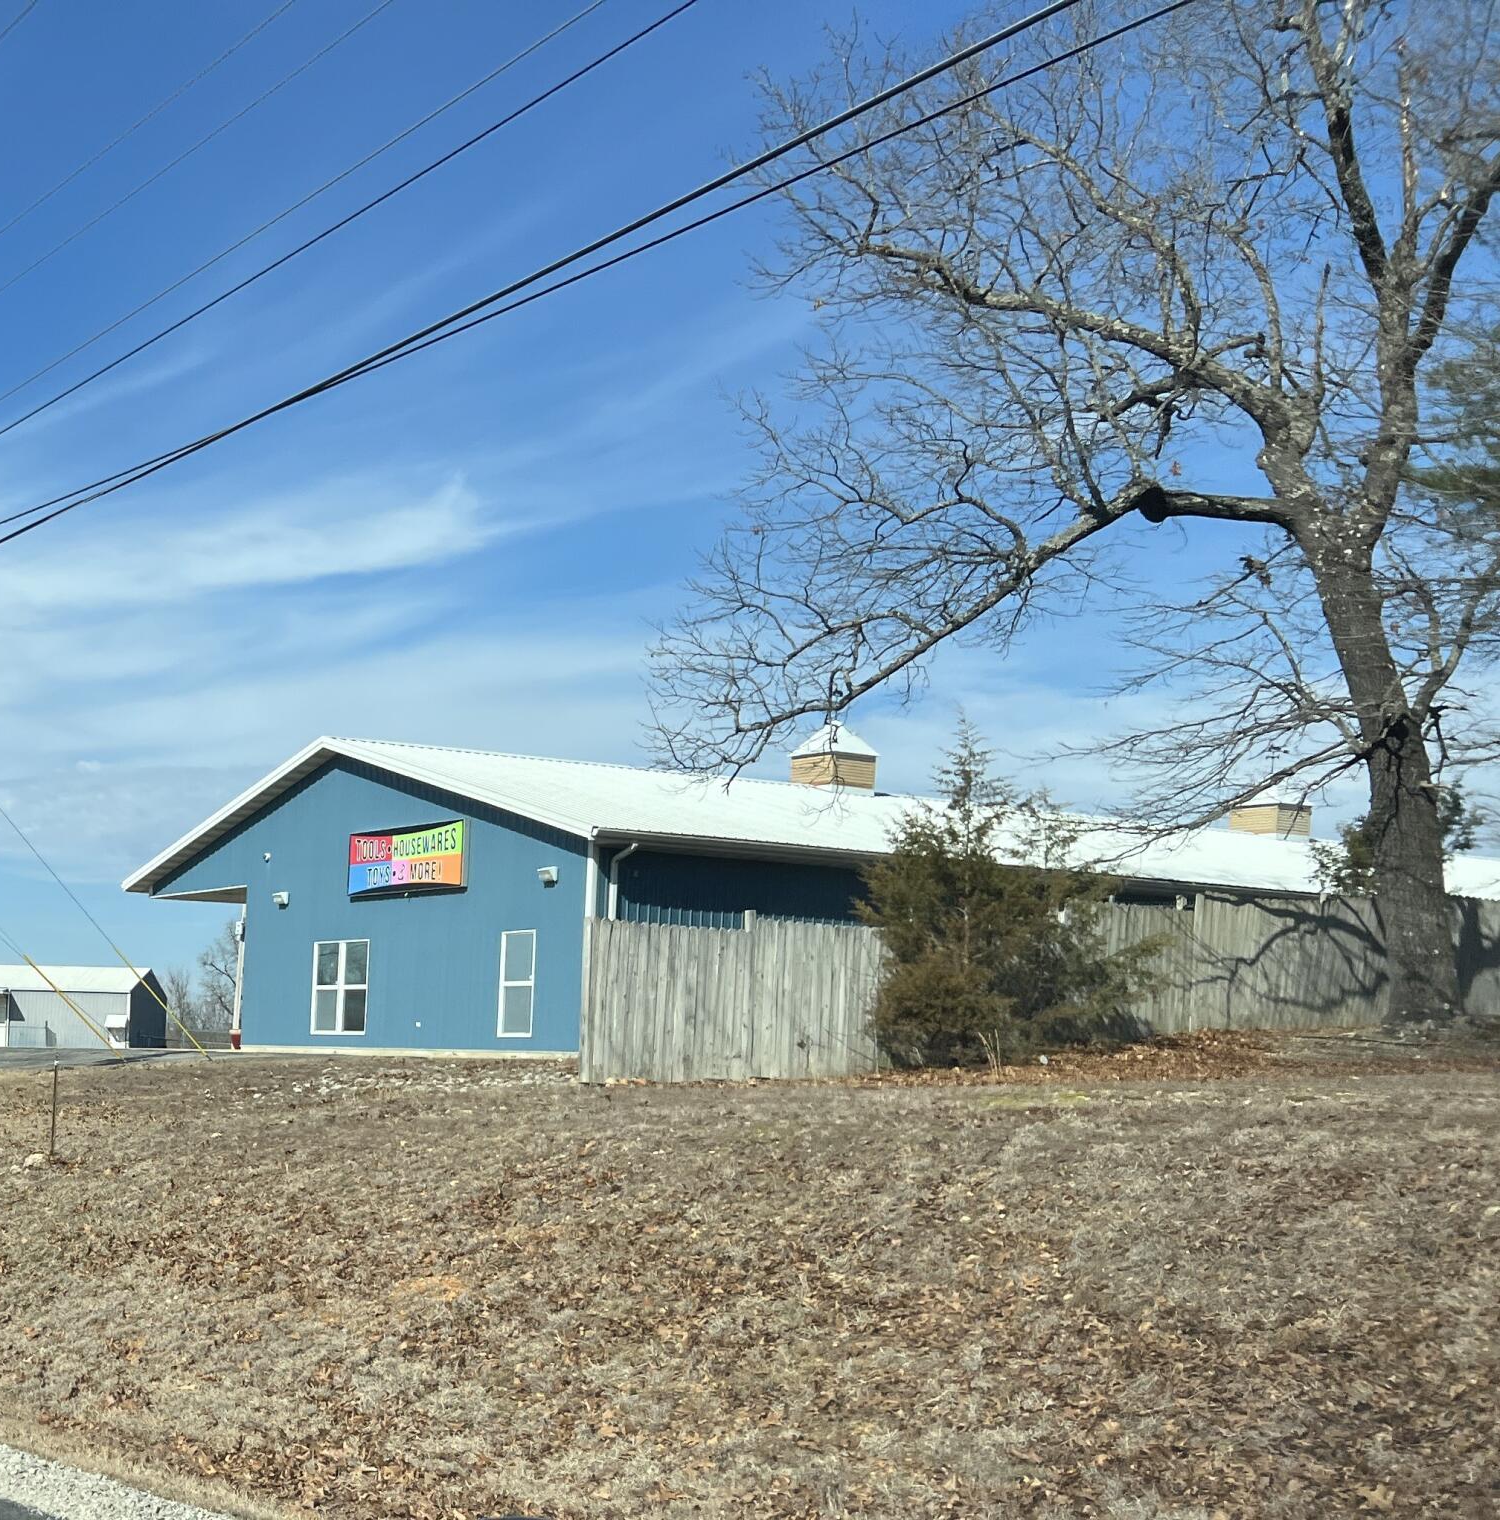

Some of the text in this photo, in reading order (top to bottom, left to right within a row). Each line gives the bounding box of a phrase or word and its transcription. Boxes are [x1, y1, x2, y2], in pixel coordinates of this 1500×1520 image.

[355, 827, 457, 862] TOOLS HOUSEWARES
[367, 865, 391, 886] TOYS
[410, 861, 443, 880] MORE!
